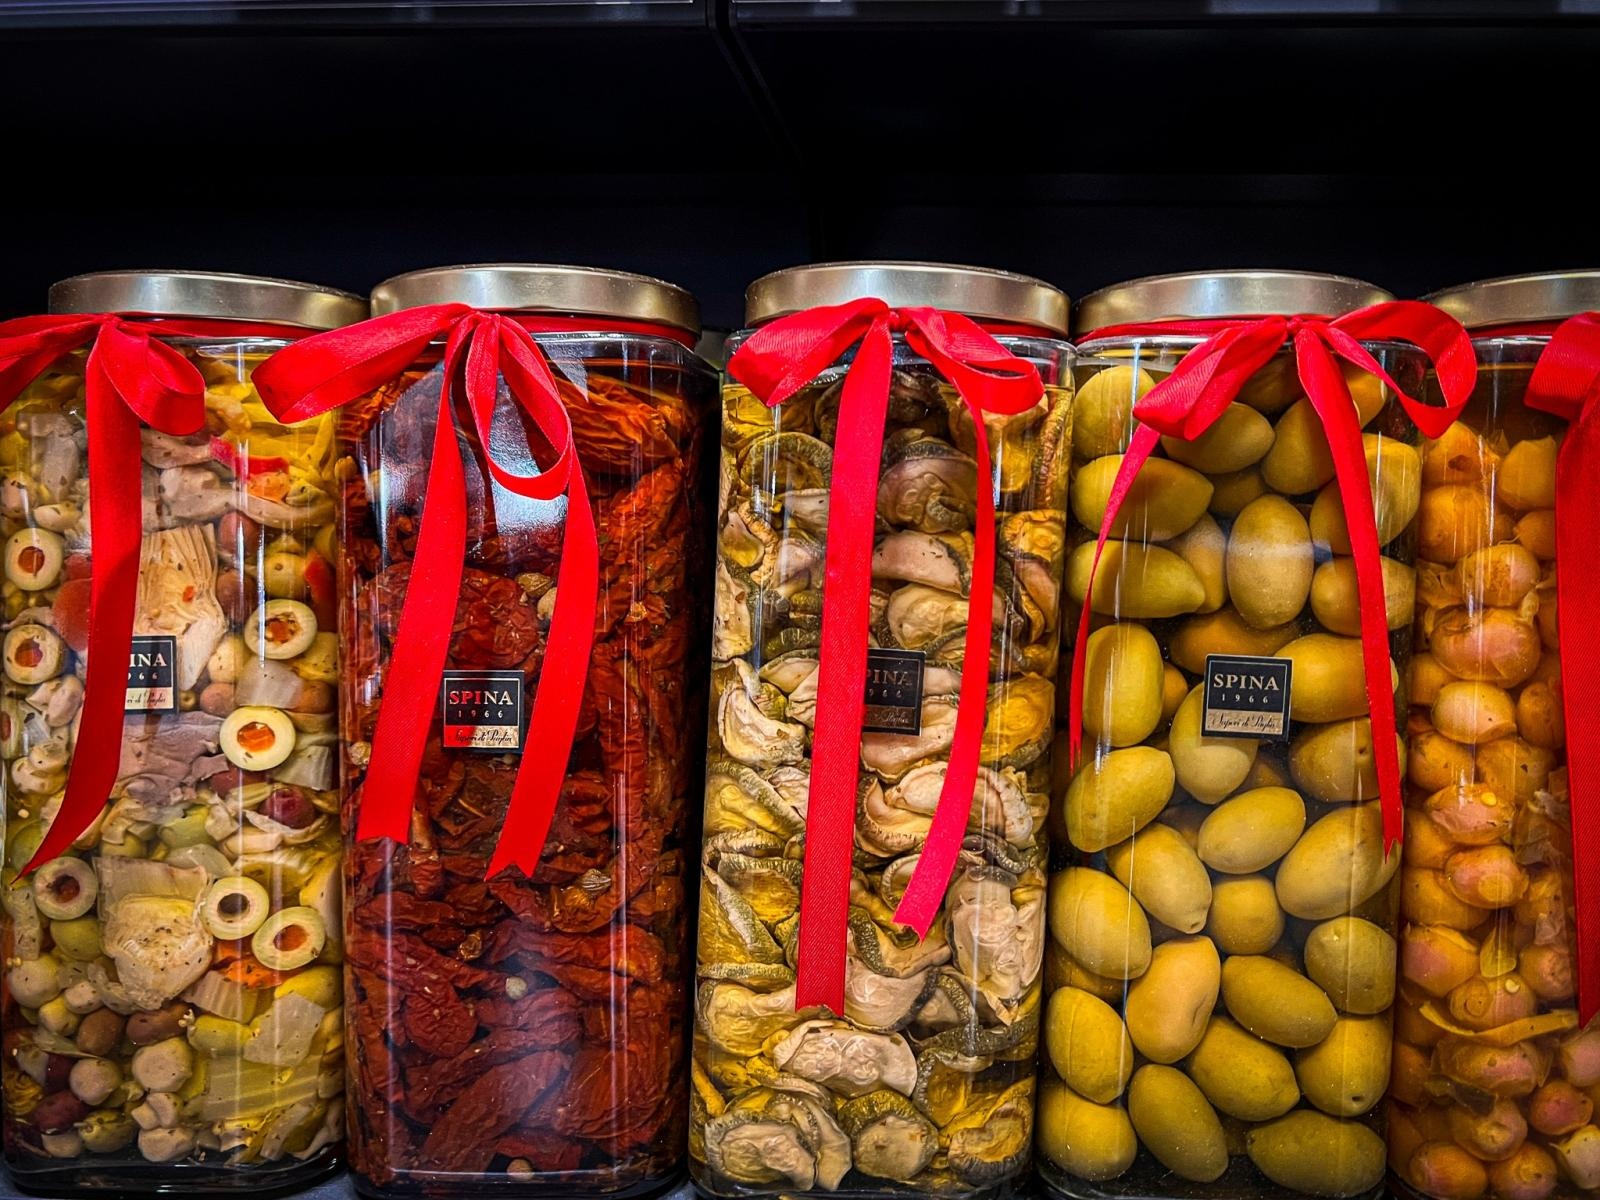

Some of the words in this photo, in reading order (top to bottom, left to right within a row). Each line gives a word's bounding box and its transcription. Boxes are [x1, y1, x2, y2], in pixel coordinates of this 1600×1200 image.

[129, 653, 168, 667] INA
[1213, 673, 1280, 691] SPINA
[449, 690, 514, 705] SPINA
[869, 689, 902, 697] 966
[1222, 694, 1268, 703] 1966
[458, 710, 503, 718] 1966
